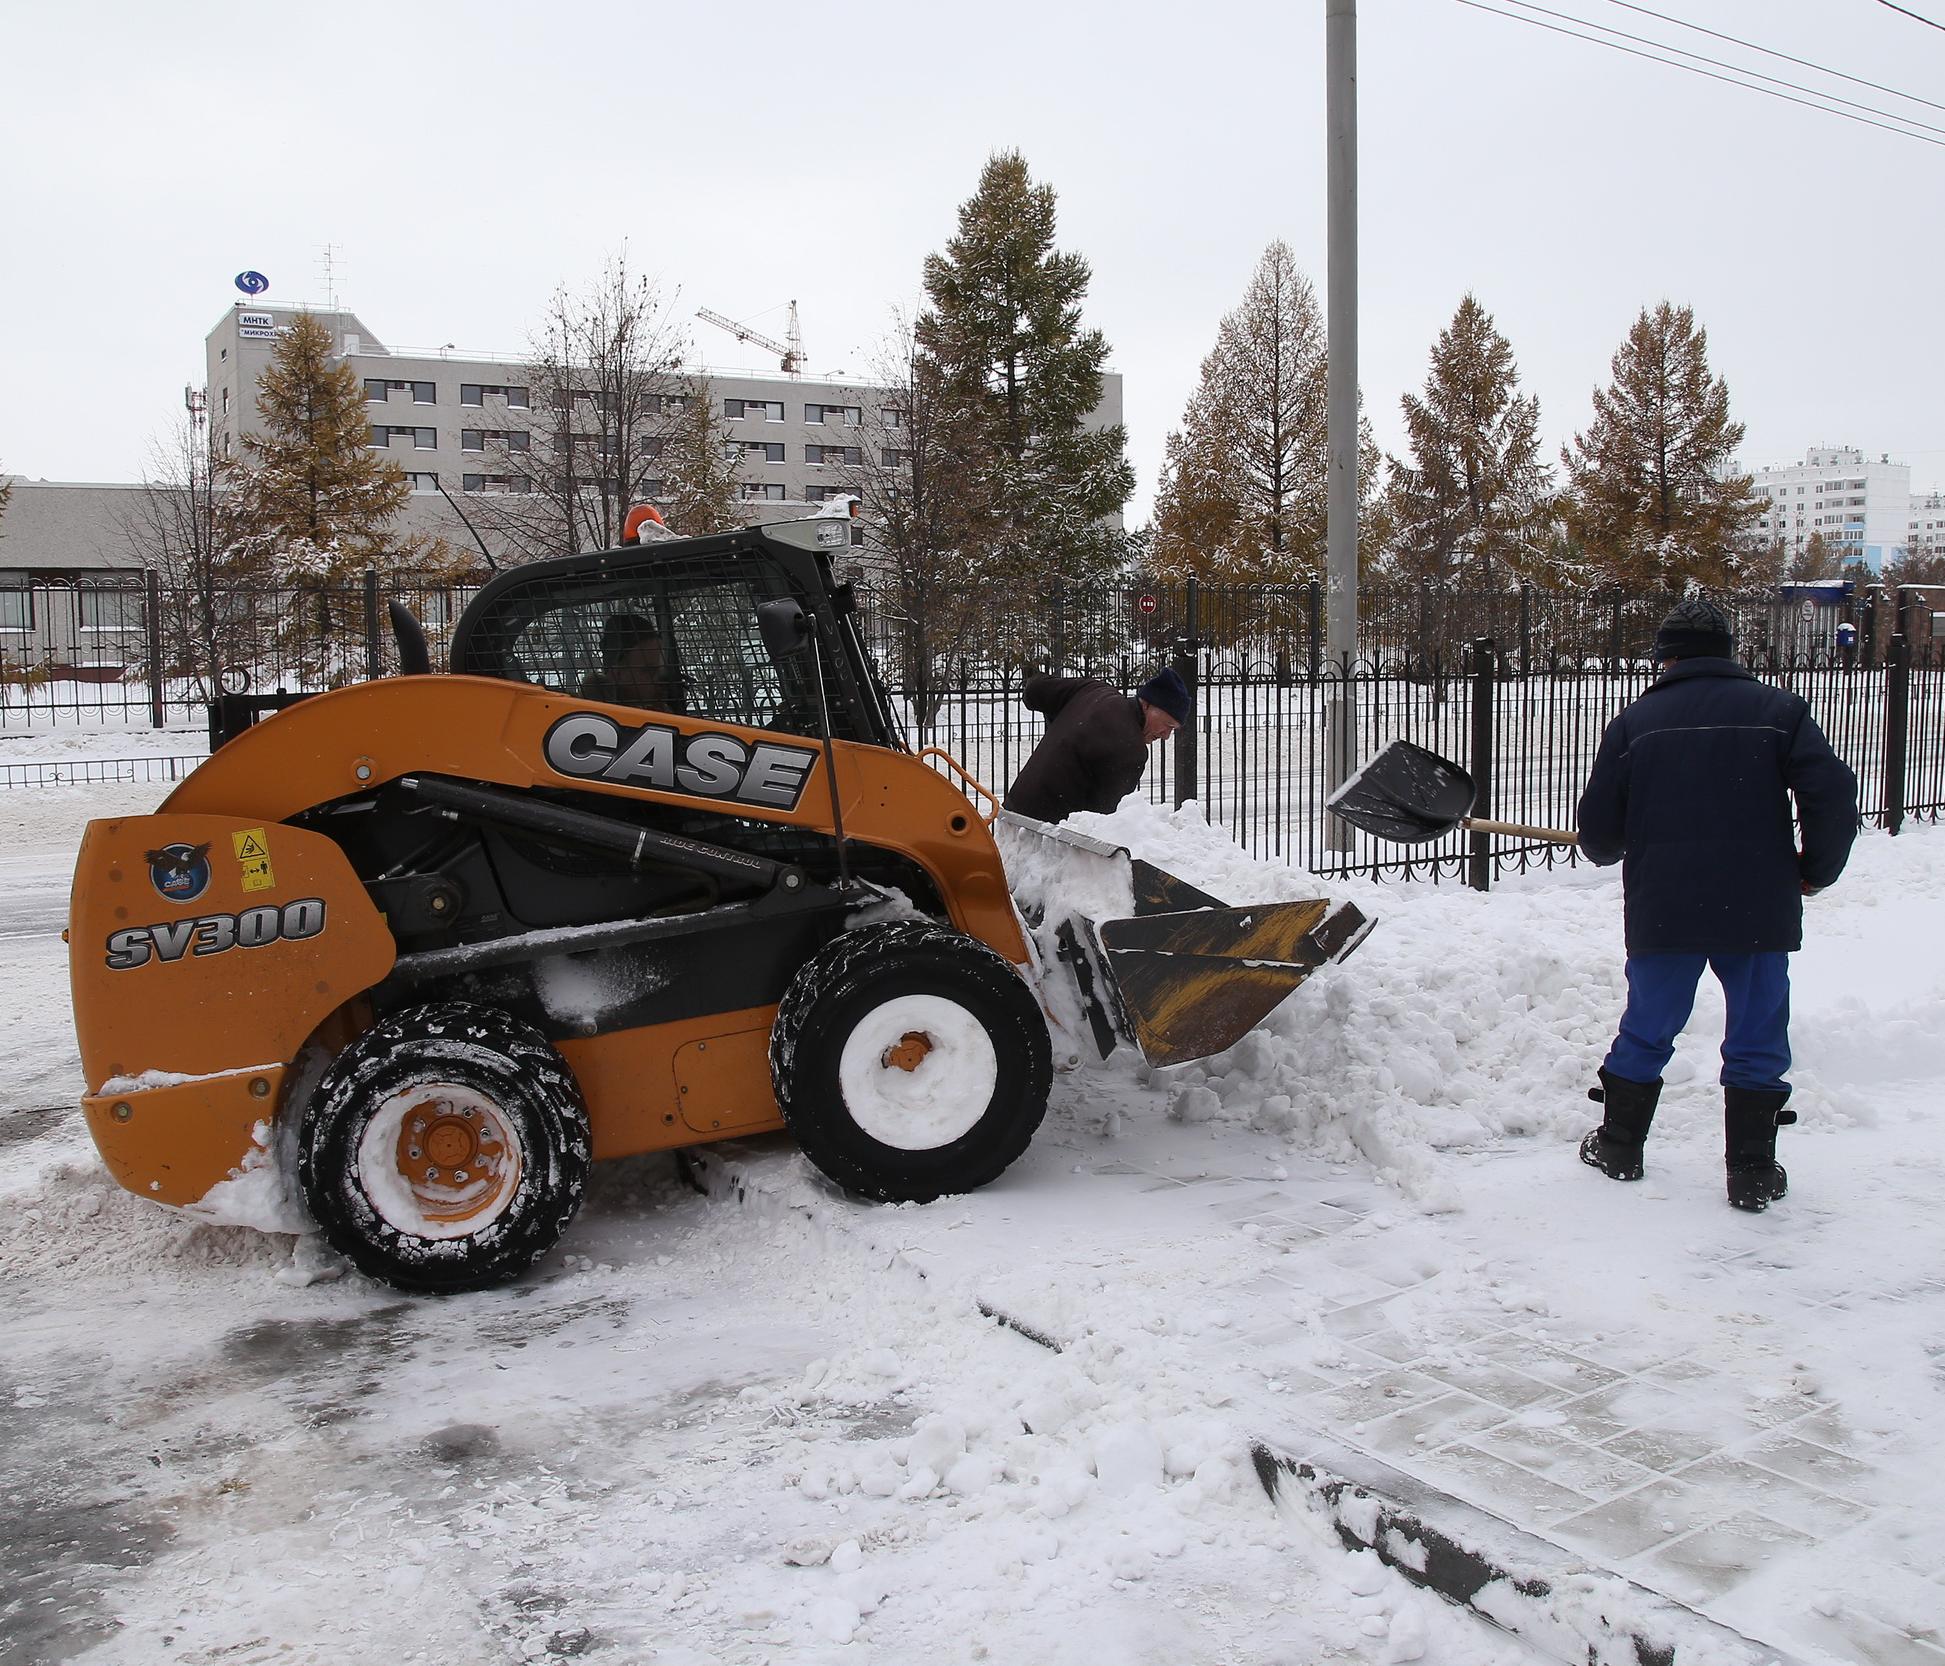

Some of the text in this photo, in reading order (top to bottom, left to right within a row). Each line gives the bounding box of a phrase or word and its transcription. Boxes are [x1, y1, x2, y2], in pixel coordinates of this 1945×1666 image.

[243, 316, 269, 325] МНТК
[548, 716, 812, 805] CASE
[696, 845, 761, 869] CONTROL
[107, 898, 326, 970] SV300
